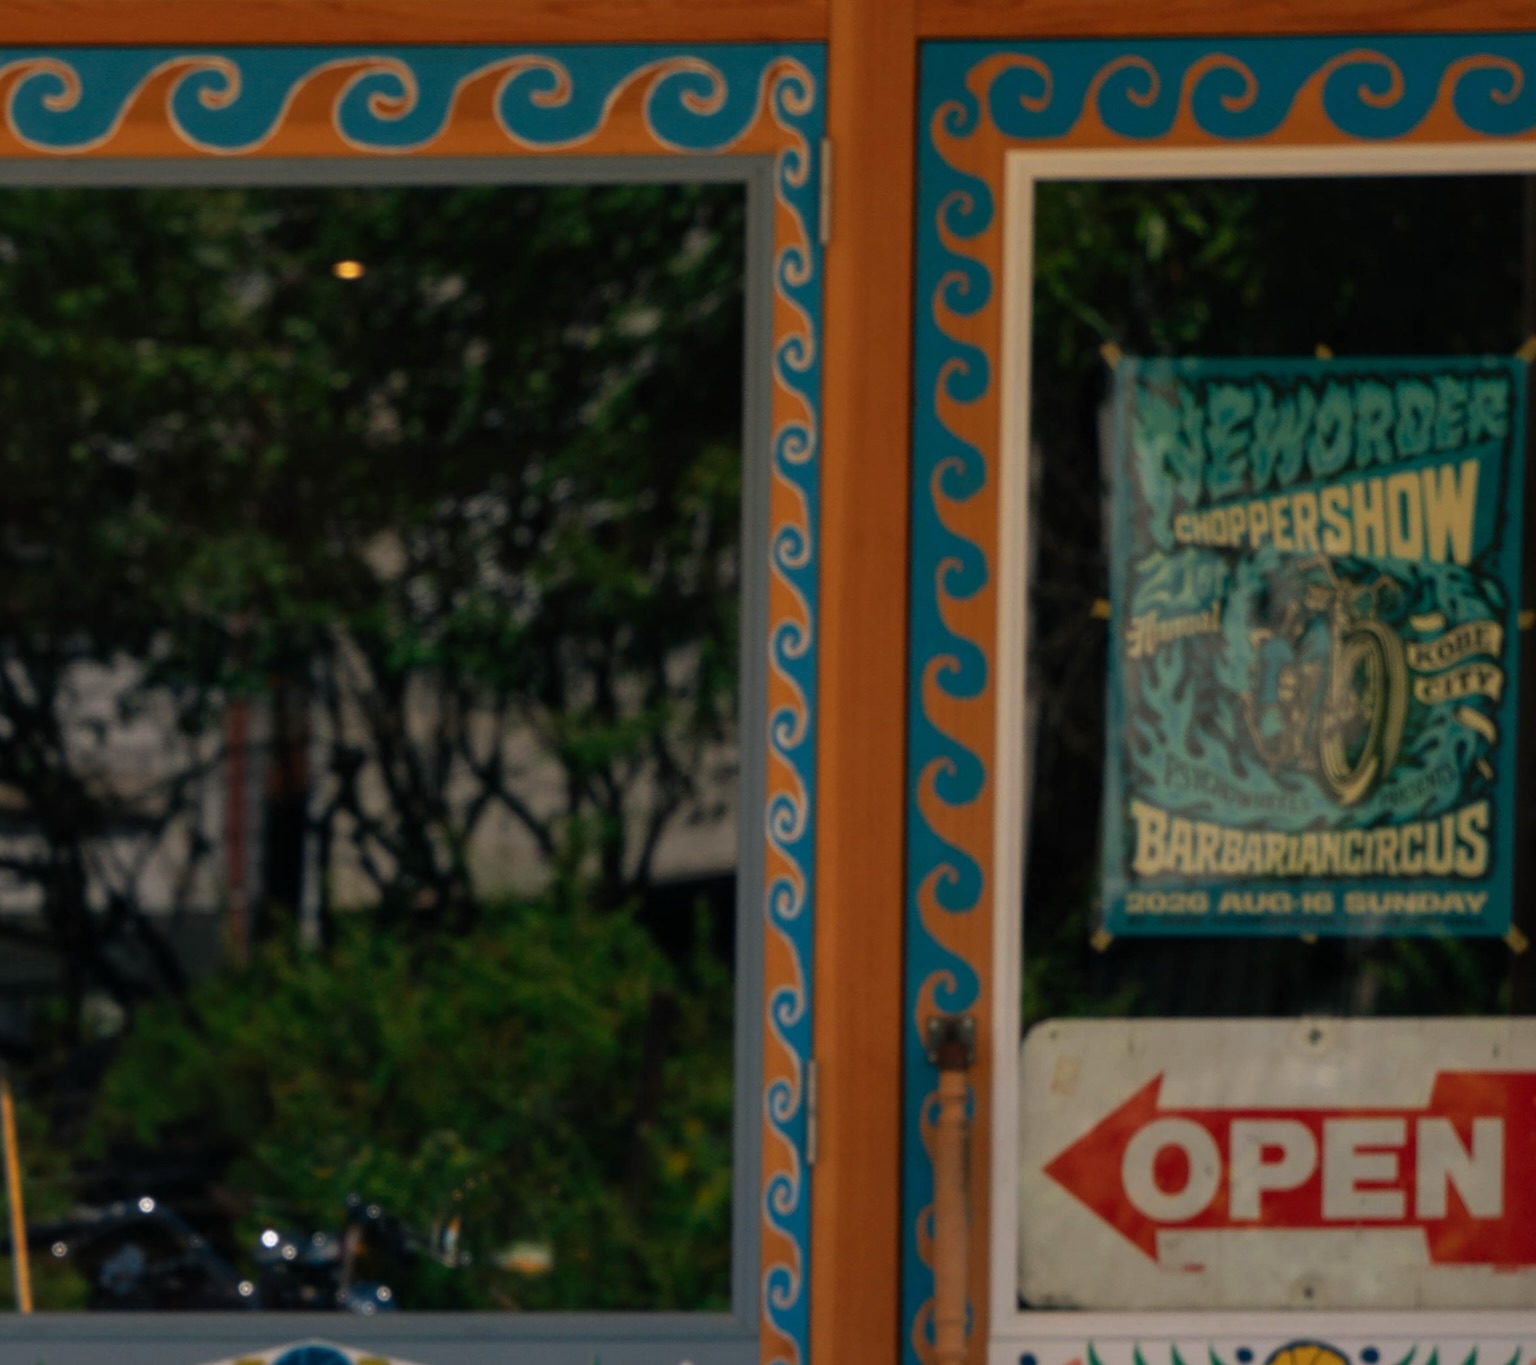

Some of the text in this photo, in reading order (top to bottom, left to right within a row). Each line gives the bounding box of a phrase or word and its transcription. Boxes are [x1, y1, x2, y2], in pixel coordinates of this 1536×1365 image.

[1131, 799, 1488, 878] BARBARIANCIRCUS
[1343, 891, 1489, 915] SUNDAY
[1120, 1117, 1505, 1223] OPEN
